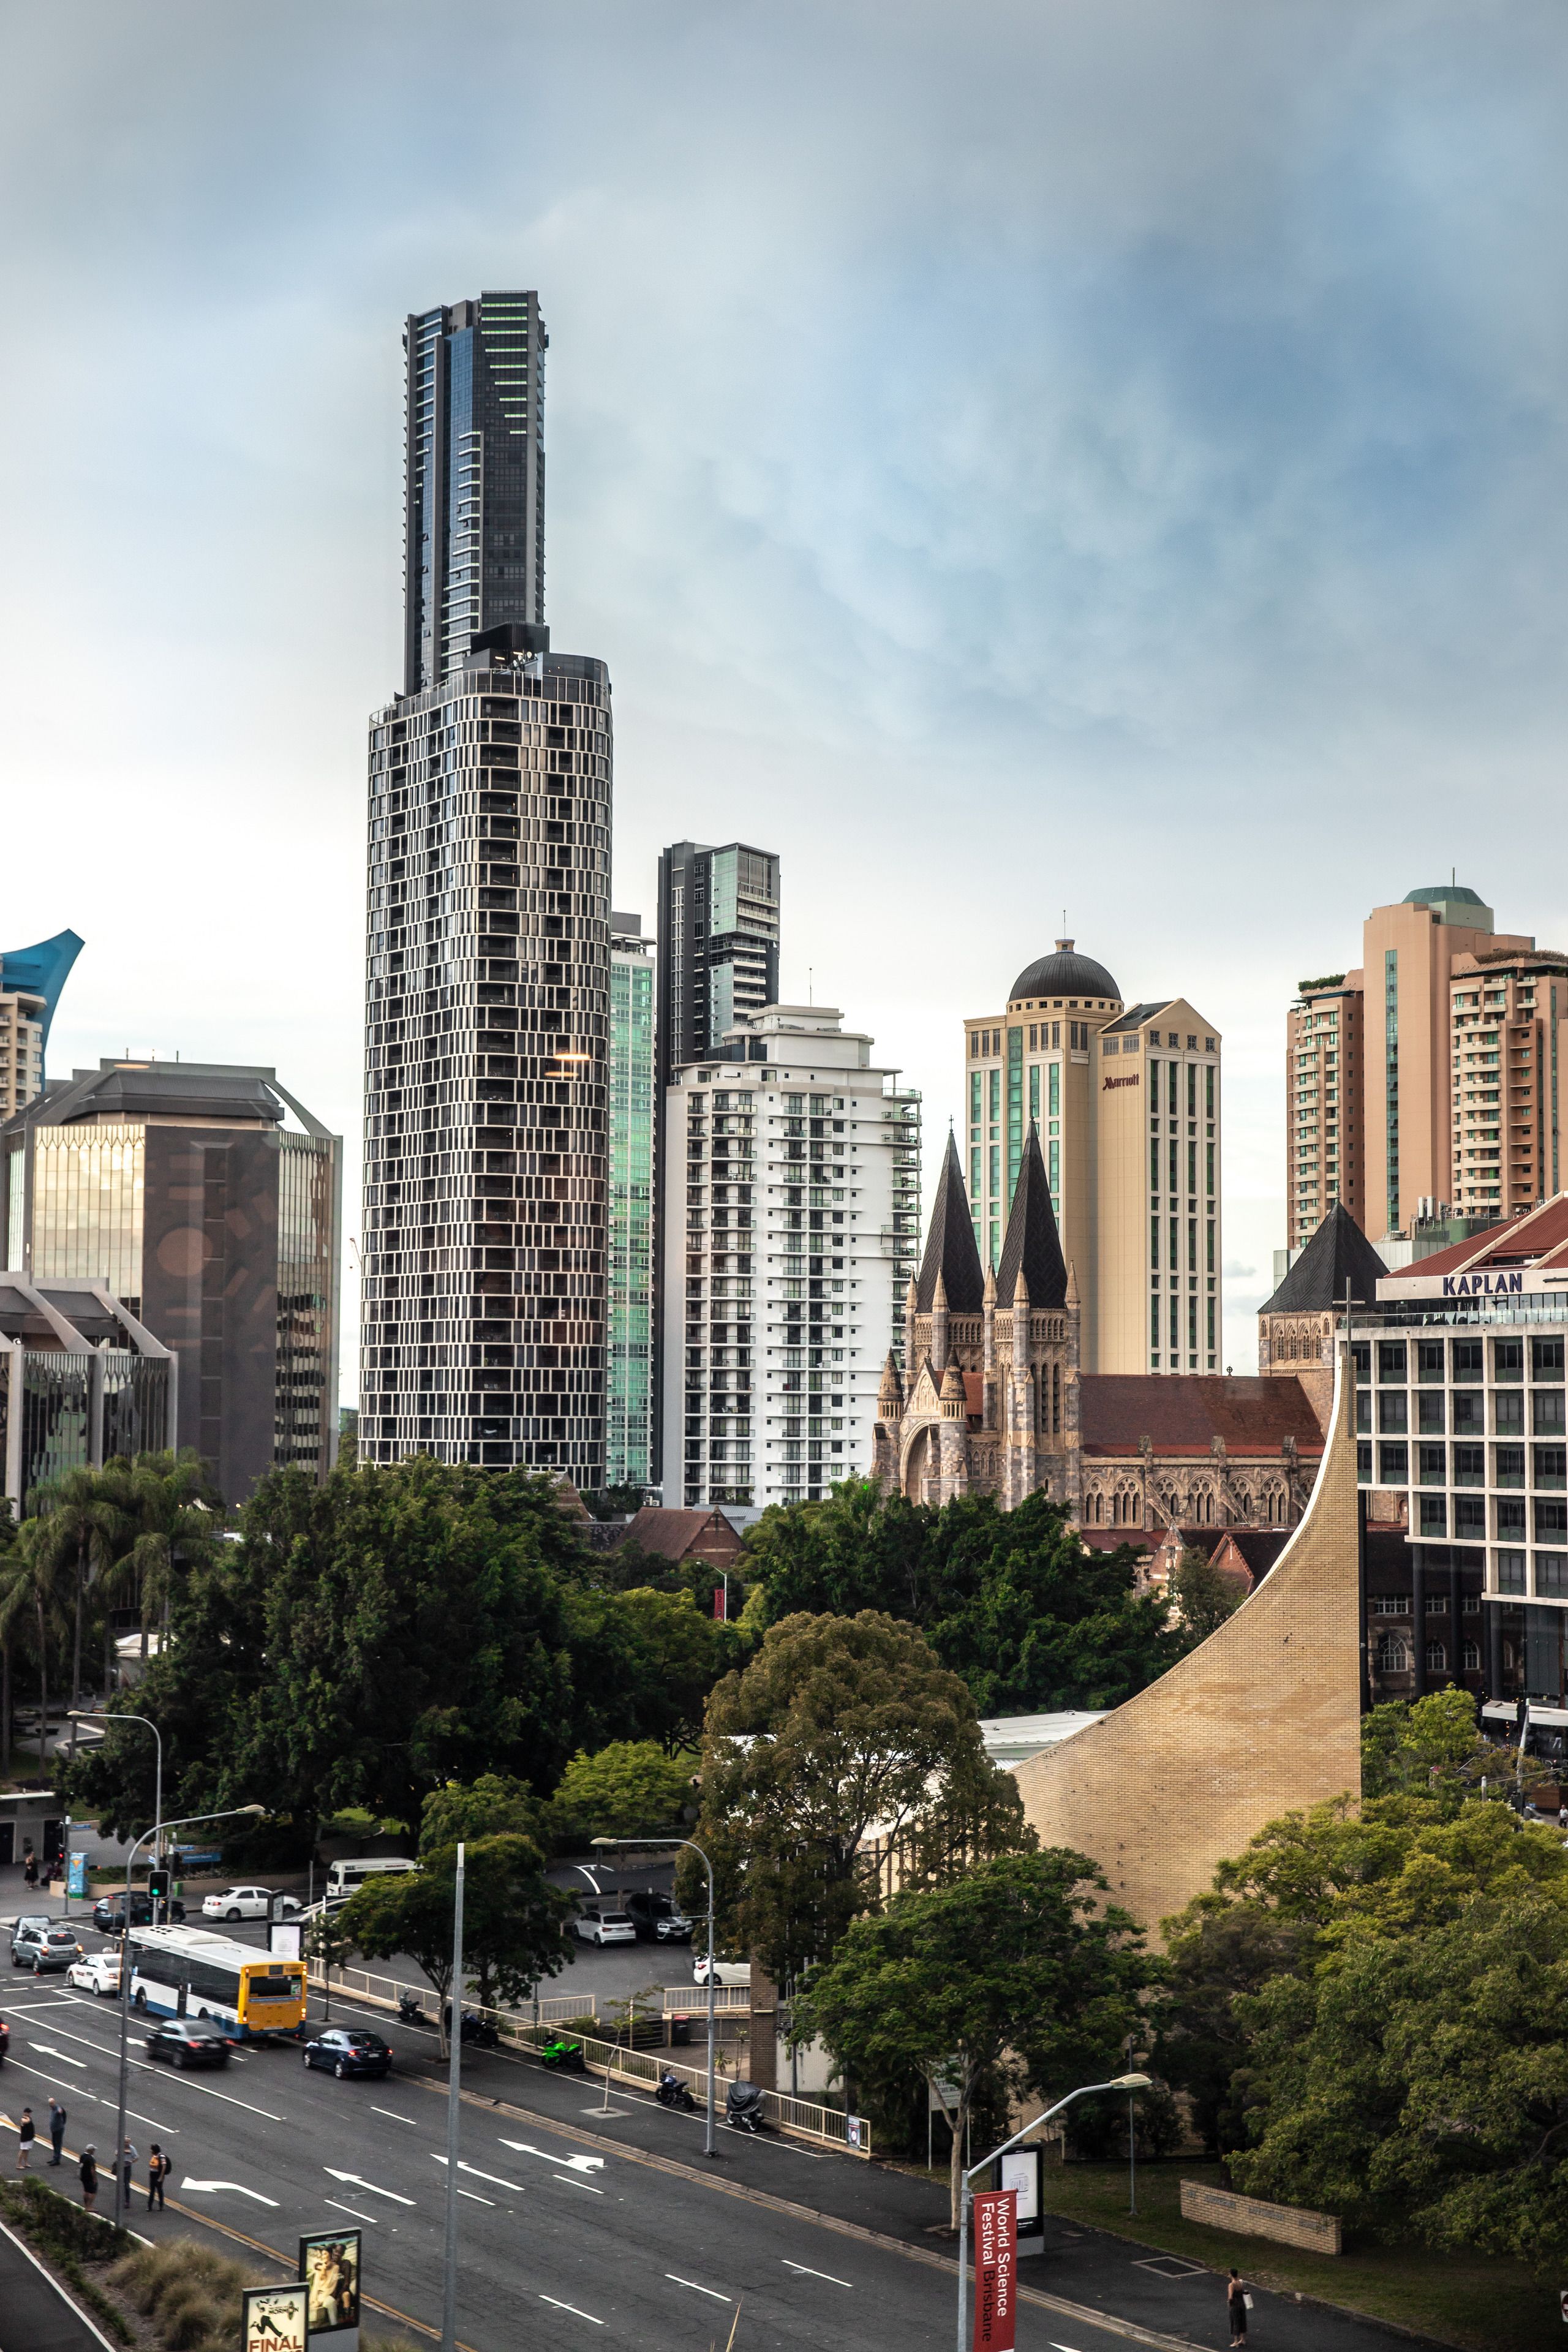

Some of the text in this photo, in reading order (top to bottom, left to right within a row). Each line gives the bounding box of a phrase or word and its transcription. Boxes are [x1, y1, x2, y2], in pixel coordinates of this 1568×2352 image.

[1102, 1073, 1139, 1091] Marriott
[1443, 1273, 1522, 1295] KAPLAN
[997, 2198, 1011, 2317] World Science
[981, 2203, 996, 2342] Festival Brisbane
[249, 2335, 303, 2352] FINAL
